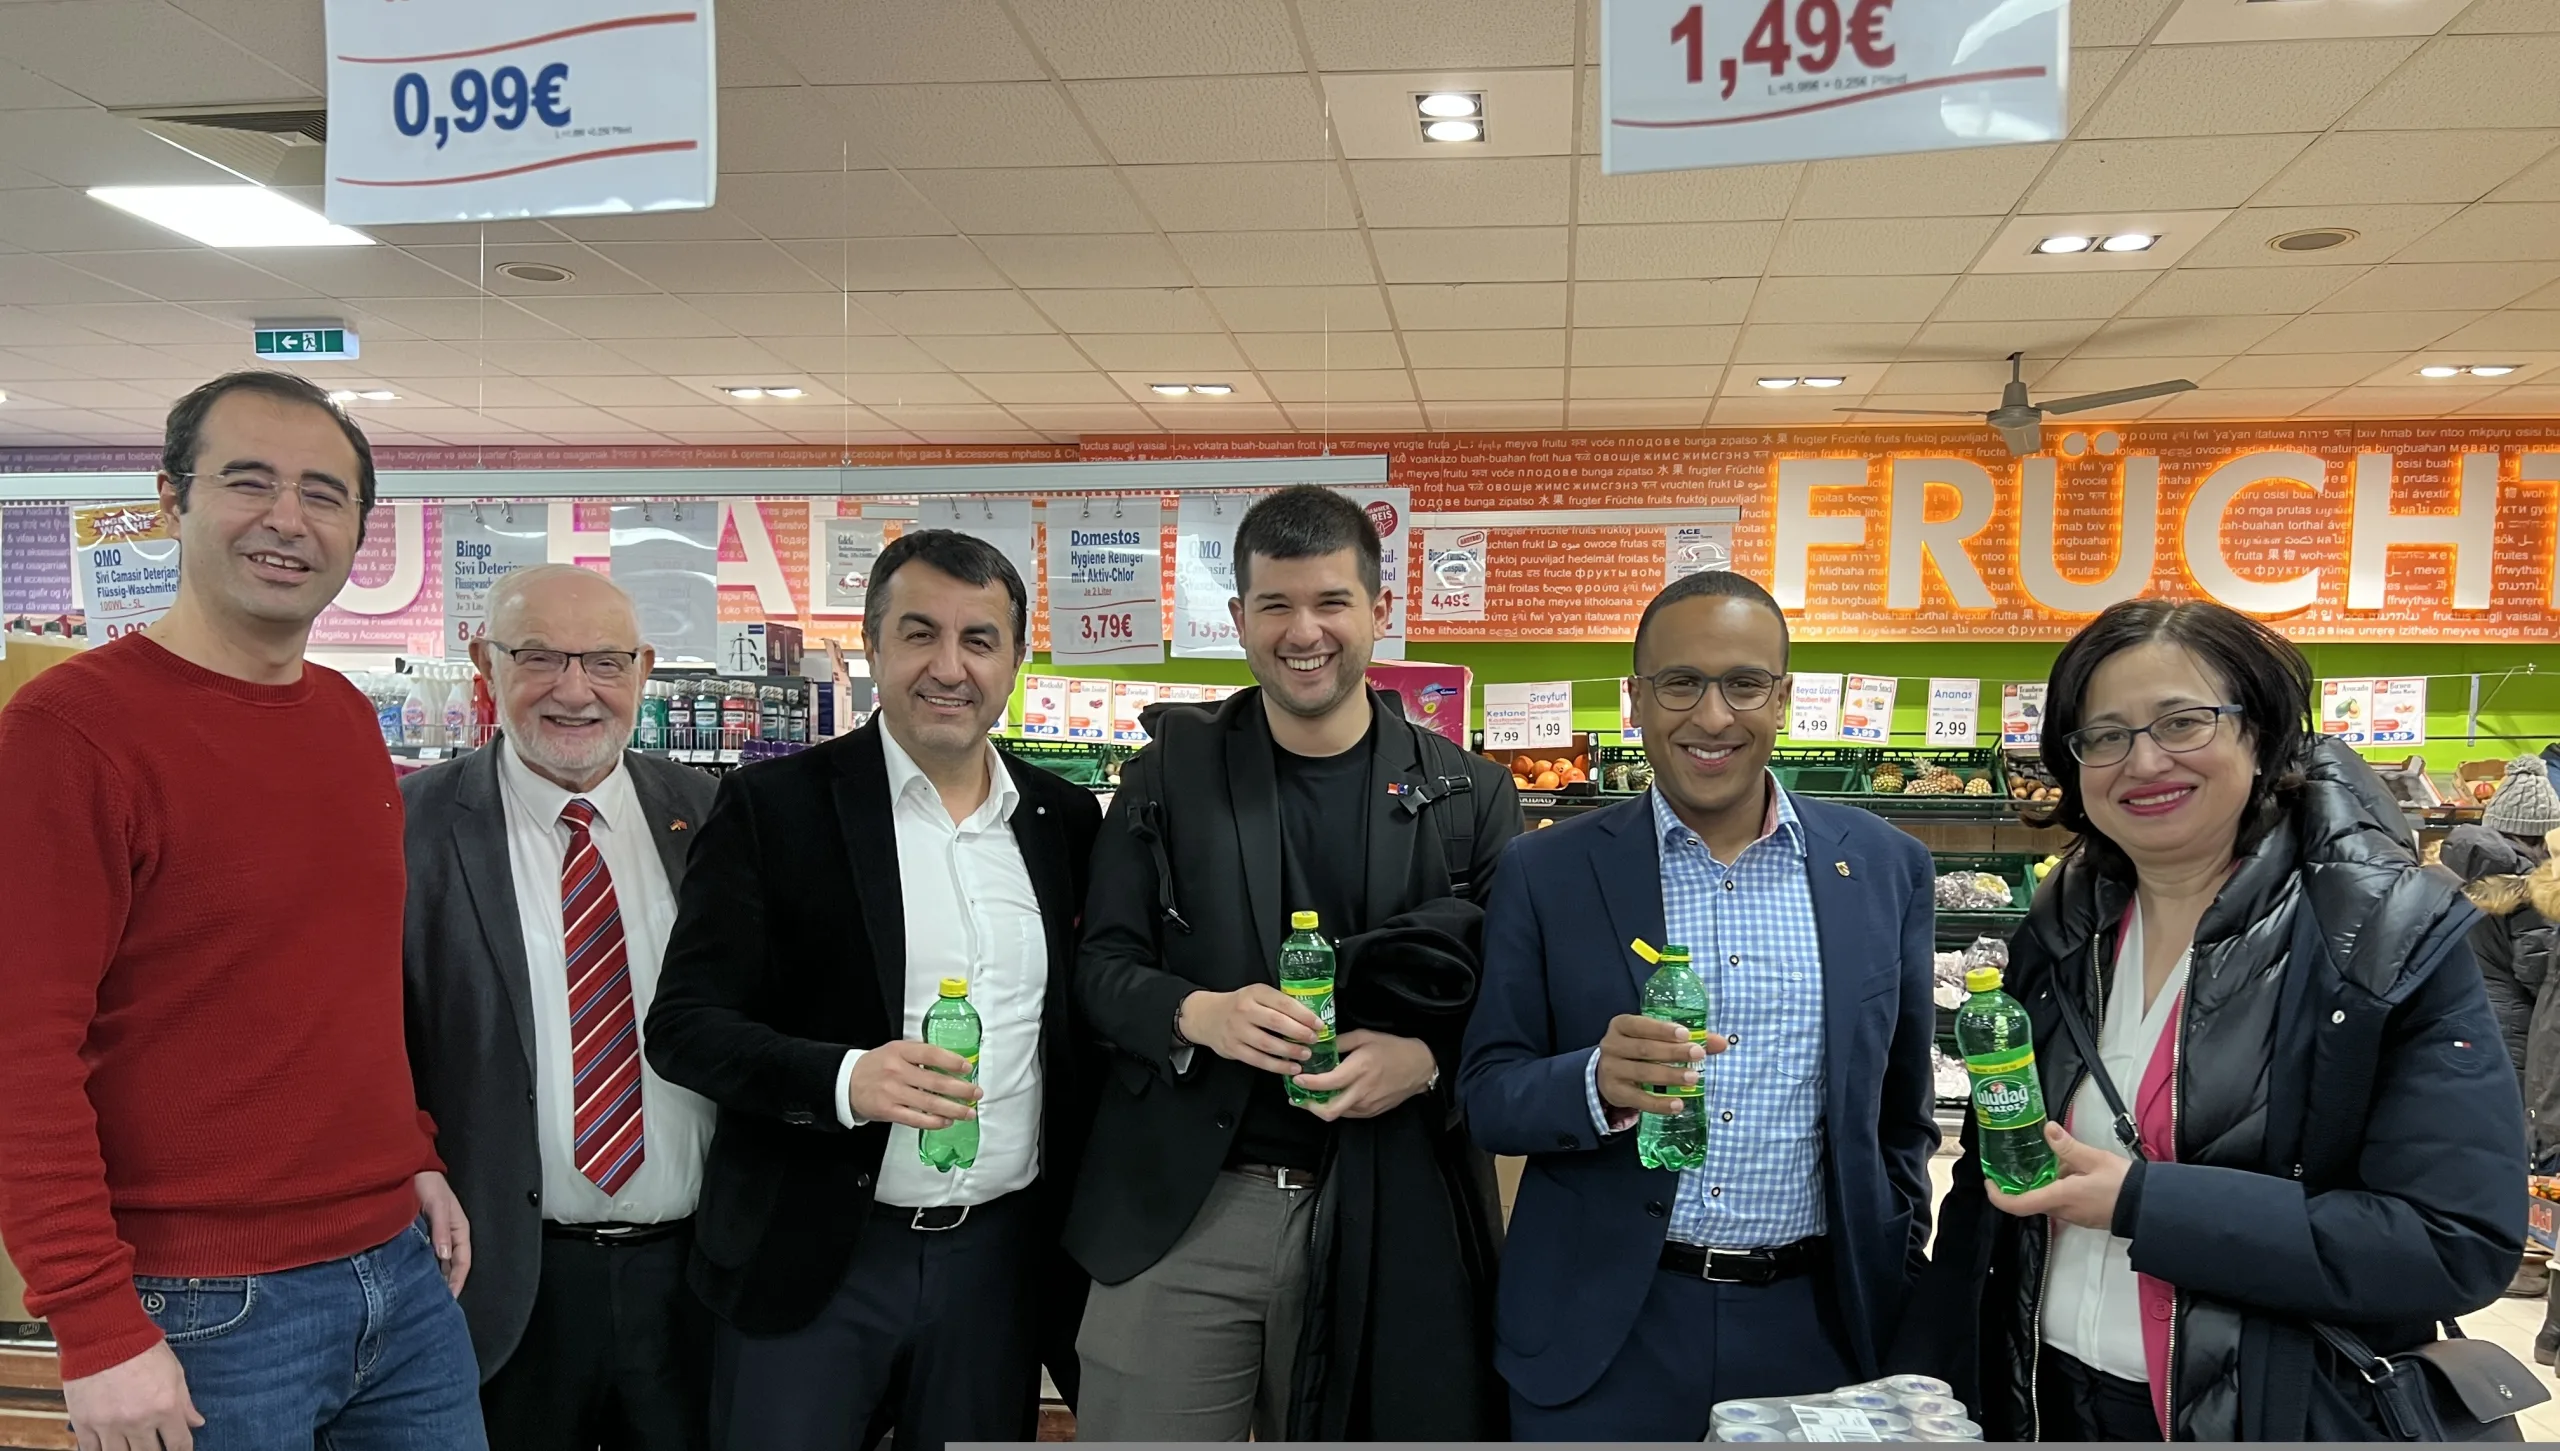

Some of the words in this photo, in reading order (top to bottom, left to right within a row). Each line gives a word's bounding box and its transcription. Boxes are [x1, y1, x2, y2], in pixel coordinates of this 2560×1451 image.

[1671, 0, 1896, 101] 1,49€
[394, 63, 573, 149] 0,99€
[1231, 434, 1294, 451] buah-buahan
[1684, 436, 1717, 448] bunga
[1720, 435, 1758, 447] zipatso
[1410, 455, 1457, 465] voankazo
[1461, 453, 1526, 464] buah-buahan
[1552, 453, 1571, 462] hua
[1581, 465, 1614, 478] bunga
[1617, 465, 1654, 478] zipatso
[1688, 465, 1722, 478] frugter
[1446, 482, 1466, 492] hua
[1660, 479, 1705, 490] vruchten
[1708, 478, 1731, 489] frukt
[1464, 498, 1496, 510] bunga
[1498, 496, 1535, 509] zipatso
[1568, 495, 1601, 508] frugter
[1647, 494, 1673, 505] fruits
[1711, 492, 1757, 506] puuviljad
[2248, 506, 2273, 519] mga
[2276, 505, 2312, 518] prutas
[1071, 530, 1141, 547] Domestos
[1522, 538, 1545, 550] frukt
[1583, 540, 1617, 549] owoce
[1619, 538, 1649, 549] frutas
[456, 540, 492, 561] Bingo
[94, 549, 123, 568] OMO
[1071, 551, 1106, 568] Hygiene
[1109, 551, 1144, 567] Reiniger
[1520, 553, 1565, 567] puuviljad
[455, 562, 475, 575] Sivi
[1494, 568, 1523, 579] frutas
[1542, 568, 1572, 579] fructe
[96, 570, 110, 585] Sivi
[111, 568, 142, 584] Camasir
[1072, 570, 1087, 584] mit
[1087, 568, 1135, 583] Aktiv-Chlor
[1508, 583, 1541, 594] froitas
[1548, 598, 1582, 610] meyve
[1081, 613, 1133, 644] 3,79€
[1520, 626, 1554, 637] ovocie
[1587, 625, 1631, 636] Midhaha
[1972, 626, 2005, 636] ovoce
[2441, 627, 2480, 639] meyve
[2483, 626, 2520, 640] vrugte
[1934, 689, 1973, 700] Ananas
[1487, 709, 1527, 718] Kestane
[1535, 722, 1561, 739] 1,99
[1798, 720, 1828, 733] 4,99
[1935, 721, 1967, 736] 2,99
[1492, 731, 1519, 744] 7,99
